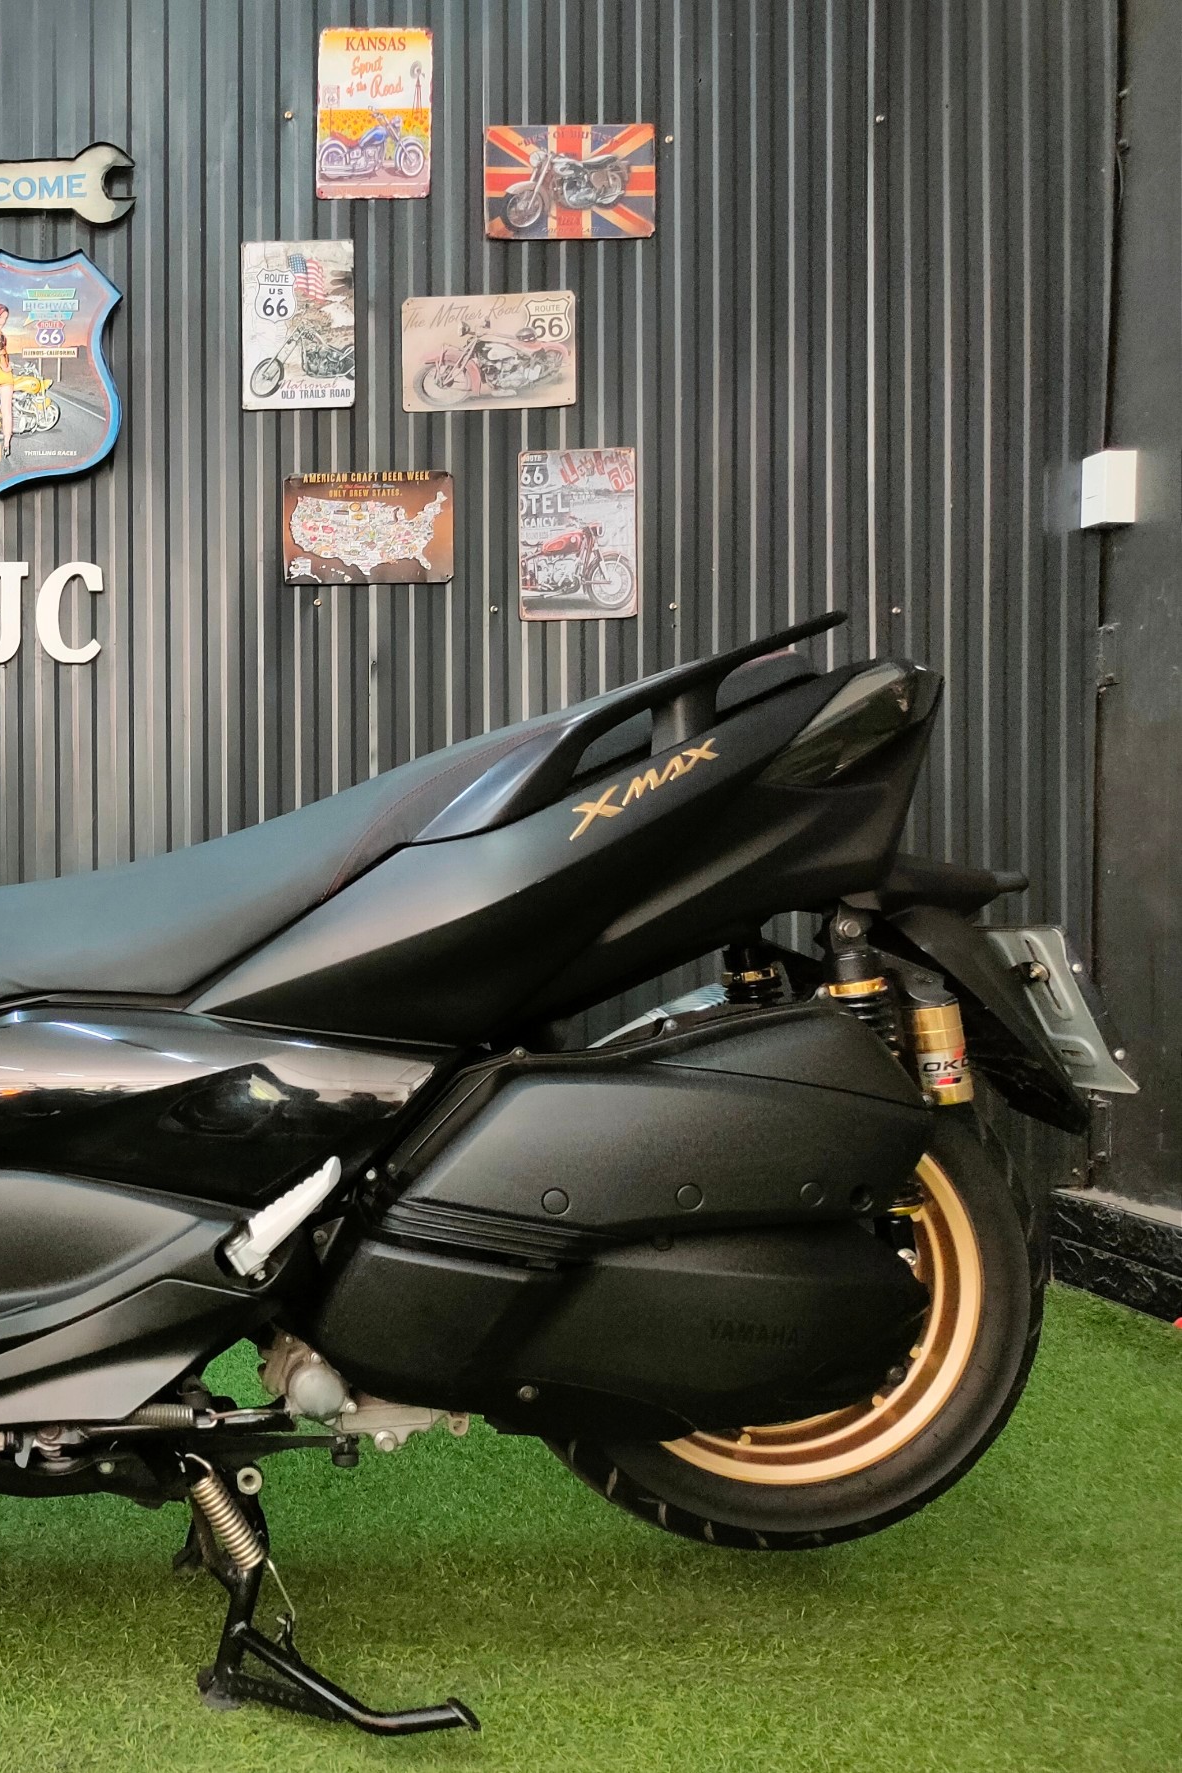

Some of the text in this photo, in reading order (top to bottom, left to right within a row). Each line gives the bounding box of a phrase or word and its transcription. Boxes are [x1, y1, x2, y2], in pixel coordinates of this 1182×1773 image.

[345, 36, 406, 51] KANSAS
[351, 56, 383, 79] Spirit
[346, 83, 354, 96] of
[370, 74, 404, 98] Road
[264, 273, 289, 283] ROUTE
[25, 302, 75, 310] HIGHWAY
[263, 298, 288, 317] 66
[403, 296, 525, 332] The Mother Road
[532, 317, 563, 339] 66
[39, 330, 61, 344] 66
[280, 376, 338, 390] National
[281, 388, 351, 399] OLD TRAILS ROAD
[303, 471, 430, 483] AMERICAN CRAFT BEER WEEK
[521, 466, 543, 485] 66
[329, 489, 346, 497] ONLY
[349, 489, 369, 497] BREW
[569, 738, 720, 841] XMAX
[708, 1319, 800, 1346] YAMAHA
